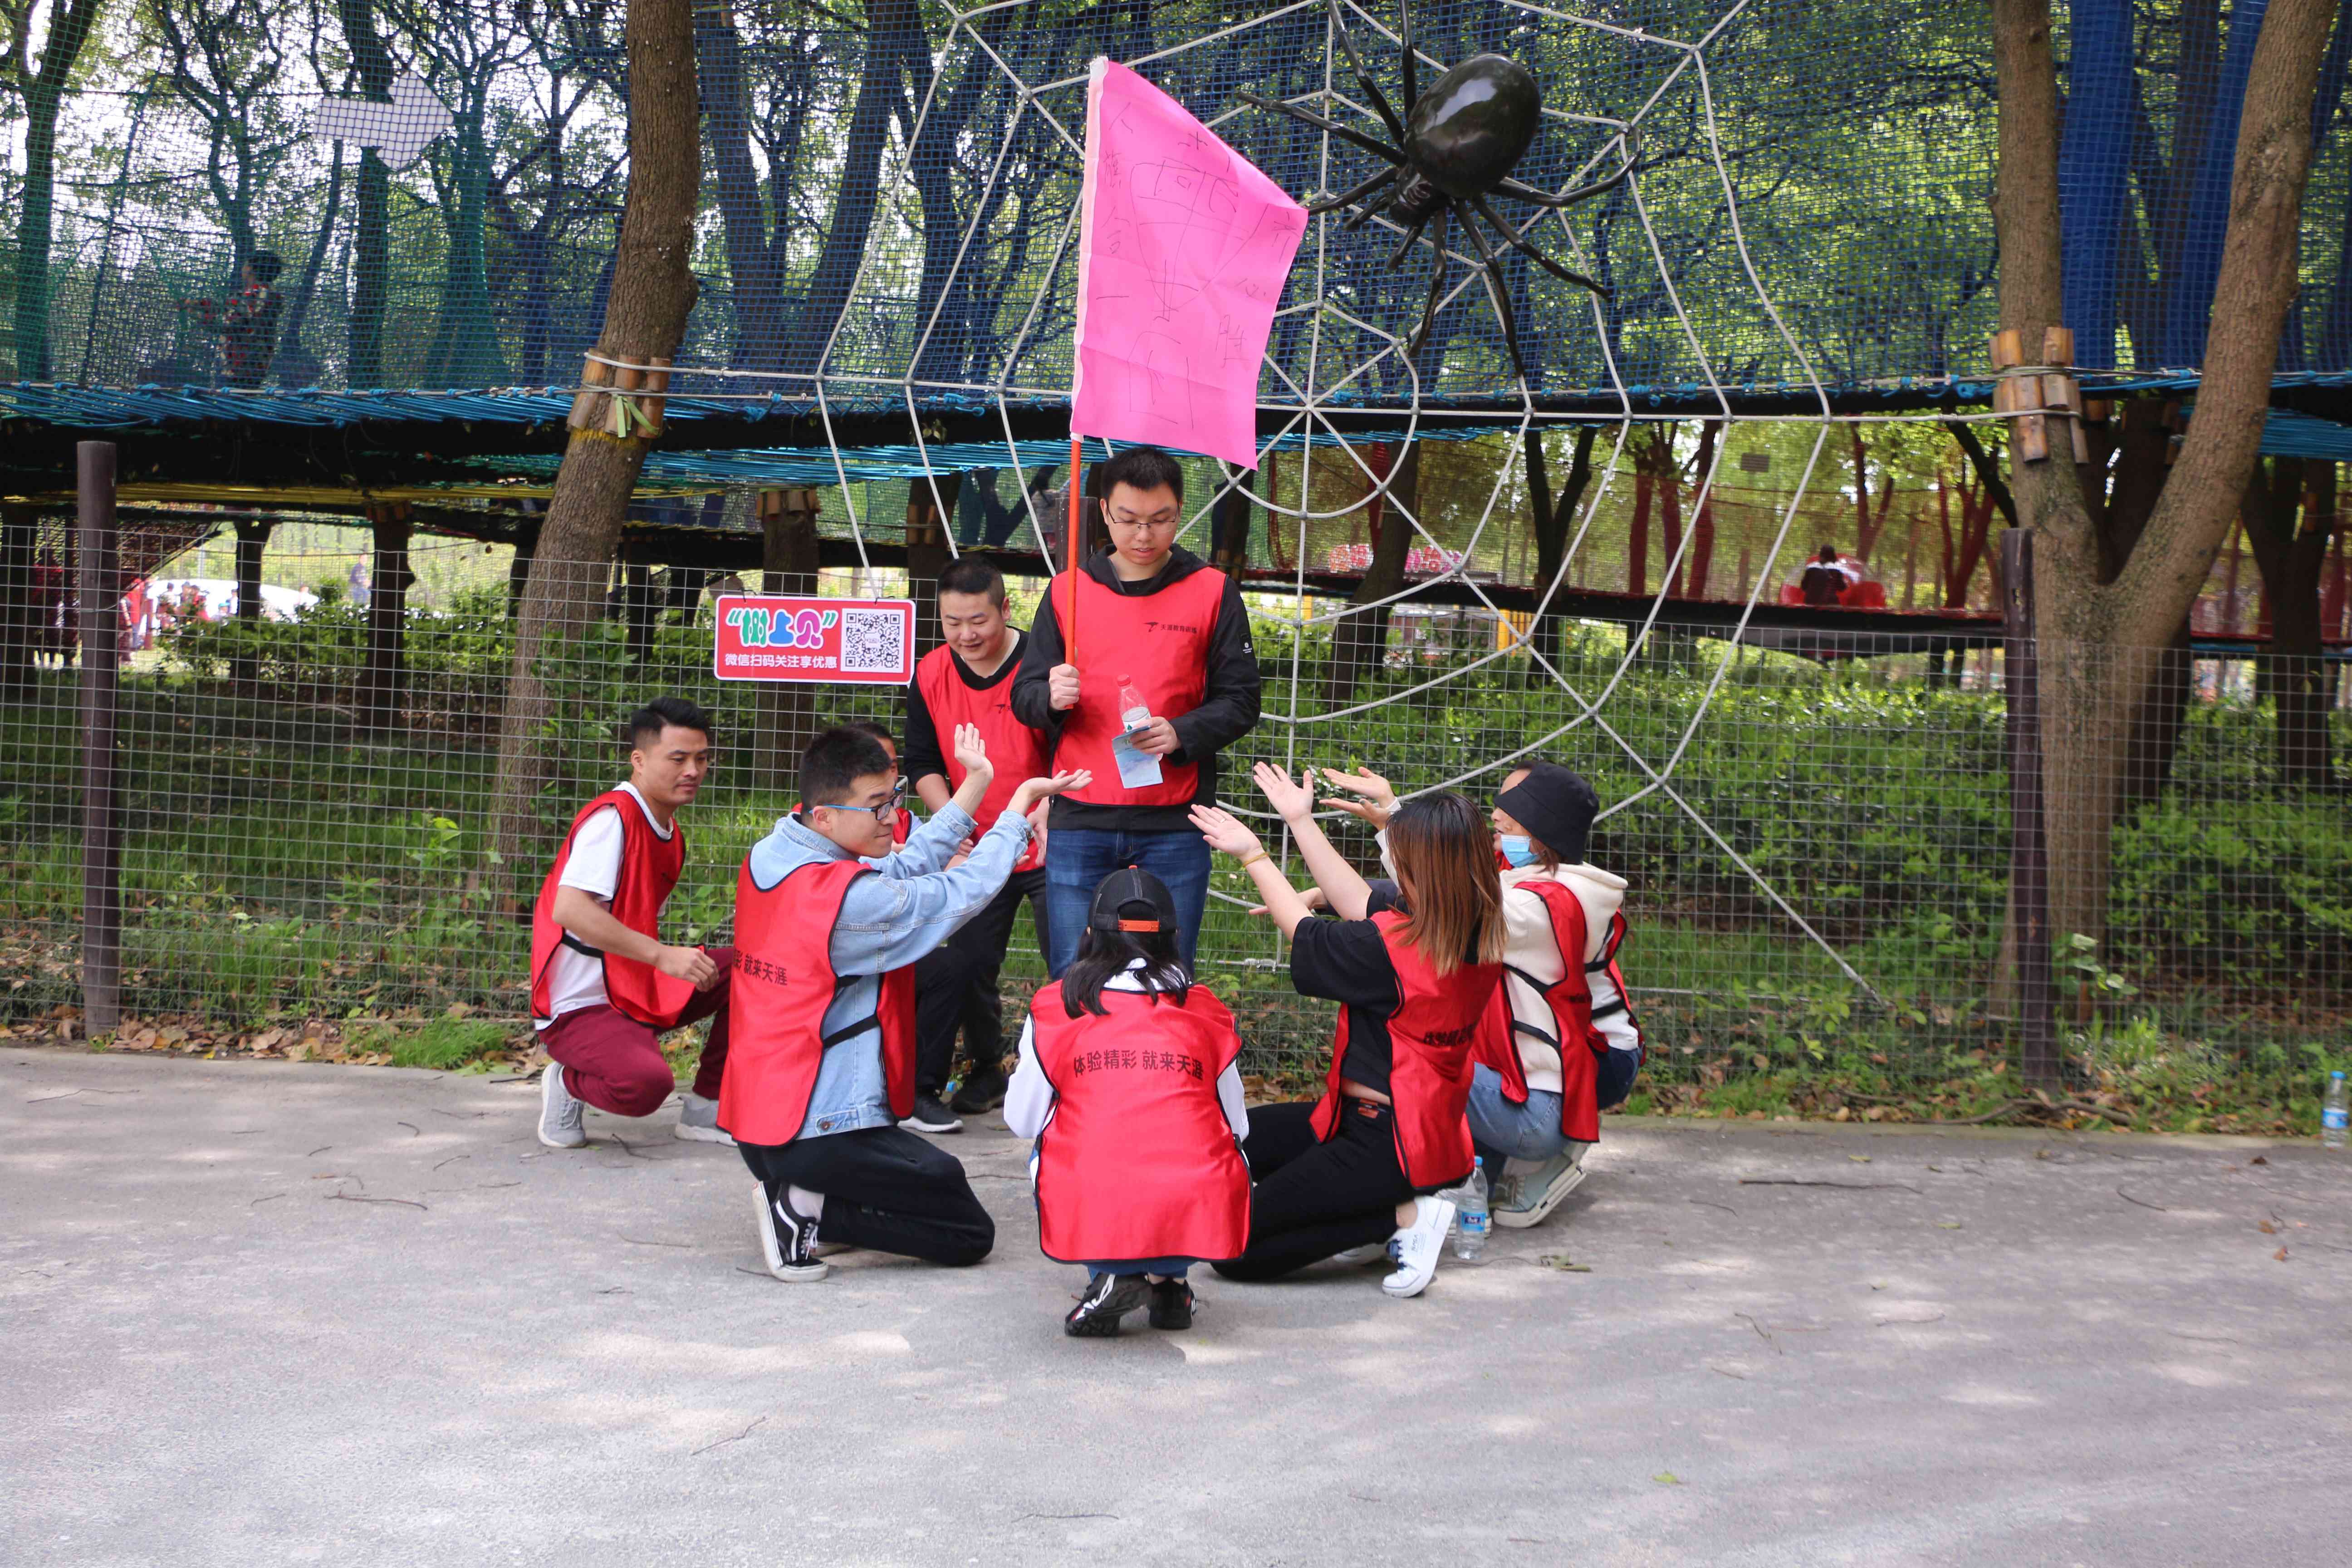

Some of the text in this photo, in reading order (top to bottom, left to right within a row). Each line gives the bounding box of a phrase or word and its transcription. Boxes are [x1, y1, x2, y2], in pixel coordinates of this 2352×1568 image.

[725, 653, 837, 669] 微信扫码关注享优惠
[744, 953, 788, 985] 就来天涯
[1074, 1049, 1204, 1082] 体验精彩 就来天涯
